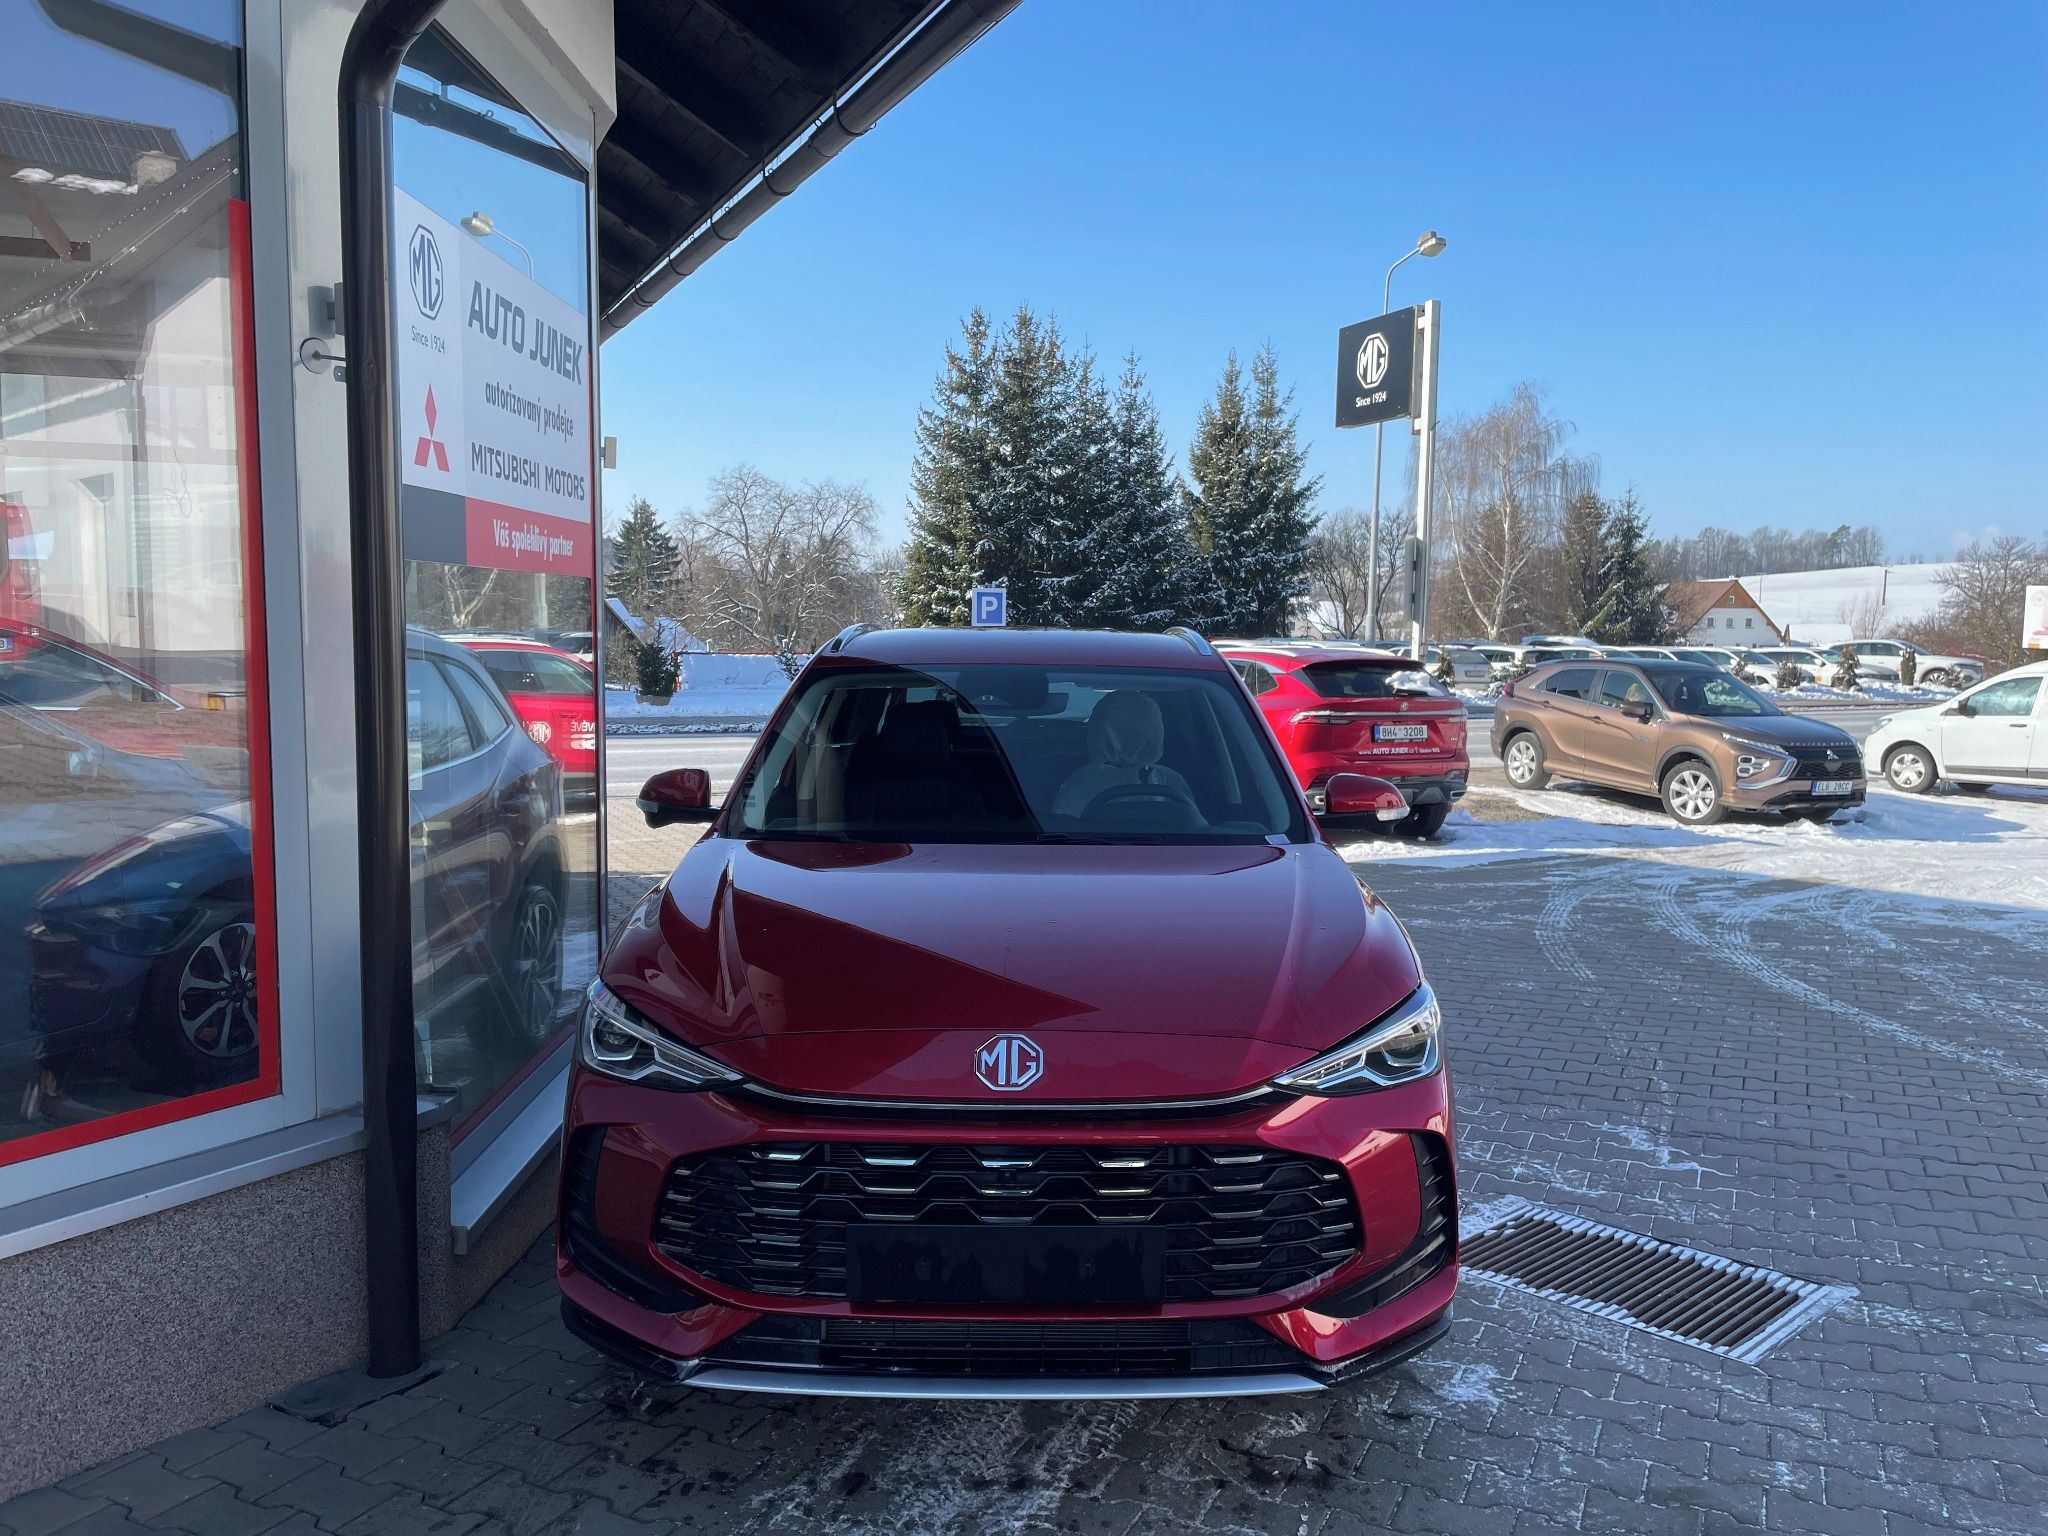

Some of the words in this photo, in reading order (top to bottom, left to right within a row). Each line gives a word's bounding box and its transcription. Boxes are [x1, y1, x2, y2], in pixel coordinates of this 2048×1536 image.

[411, 231, 442, 313] MG
[411, 325, 429, 347] Since
[430, 333, 445, 354] 1924
[468, 280, 525, 354] AUTO
[530, 318, 582, 386] JUNEK
[1358, 336, 1387, 386] MG
[485, 381, 541, 432] autorizovaný
[543, 403, 574, 443] prodejce
[1355, 396, 1371, 407] Since
[1372, 391, 1387, 404] 1924
[471, 441, 540, 489] MITSUBISHI
[545, 465, 585, 501] MOTORS
[493, 518, 509, 548] Váš
[512, 523, 548, 560] spolehlivý
[549, 534, 573, 561] partner
[981, 595, 998, 620] P
[1381, 726, 1397, 738] 8H4
[1403, 726, 1424, 737] 3208
[979, 1037, 1038, 1086] MG
